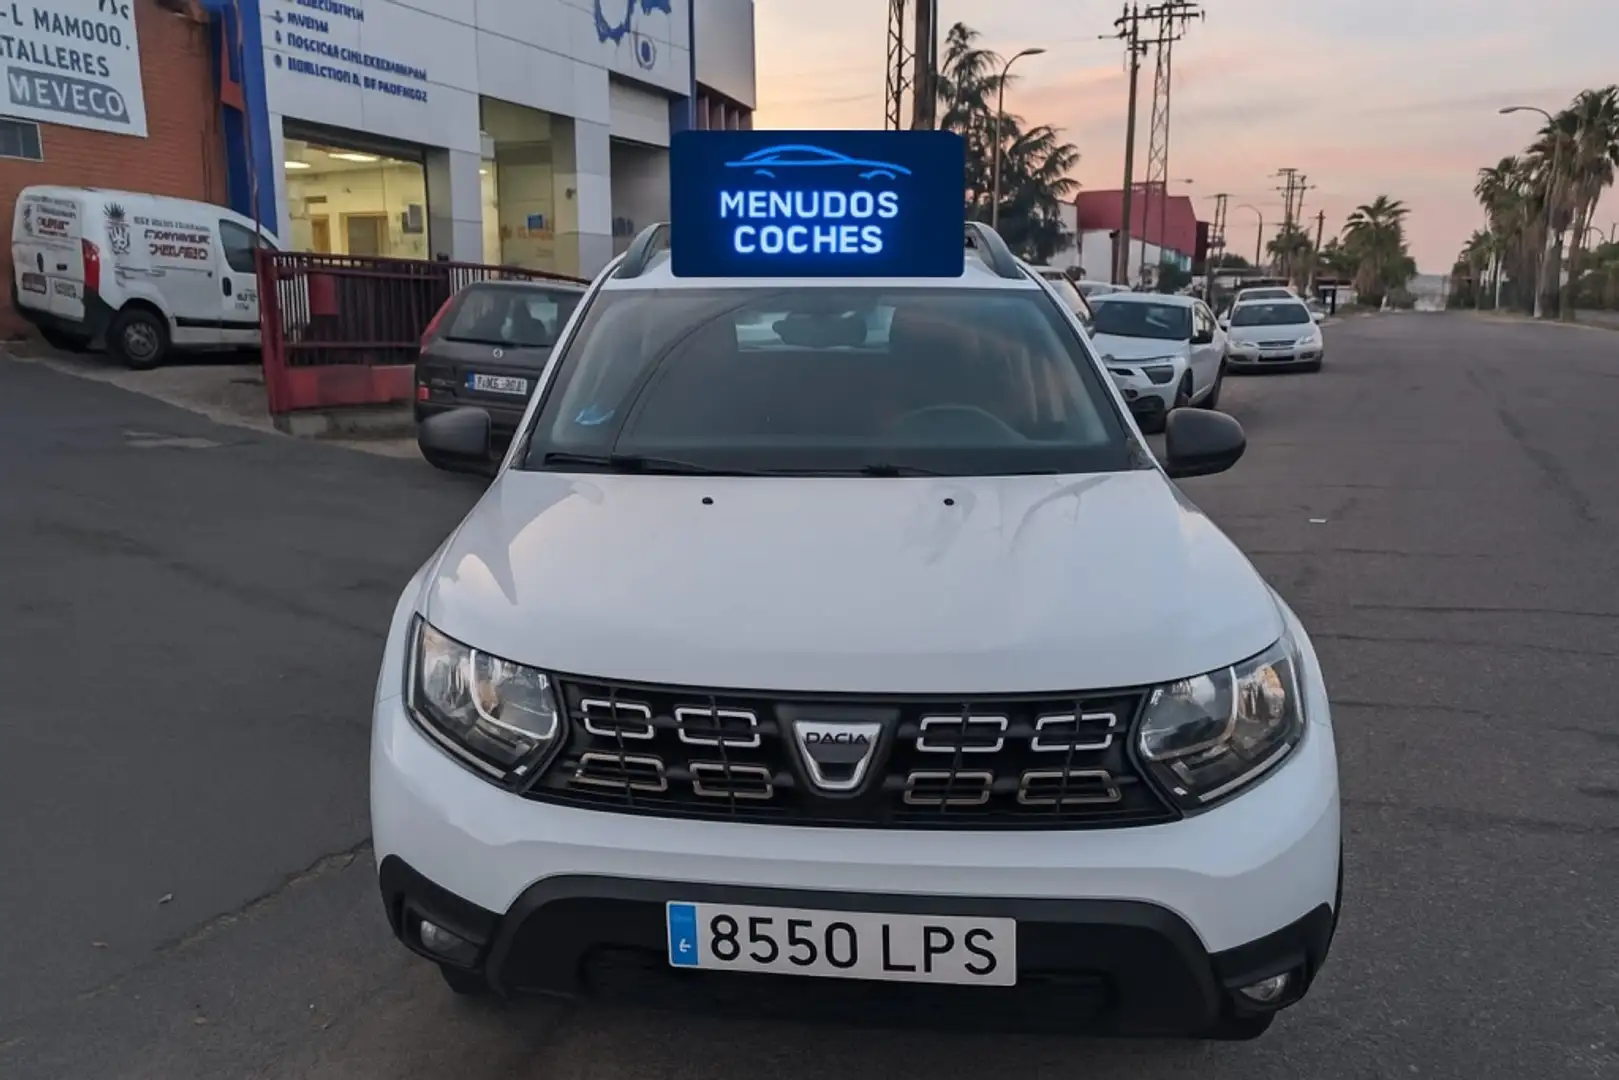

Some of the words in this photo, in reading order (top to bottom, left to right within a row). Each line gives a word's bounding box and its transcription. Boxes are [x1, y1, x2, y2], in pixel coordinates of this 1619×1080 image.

[9, 73, 125, 117] MEVECO
[720, 190, 899, 219] MENUDOS
[734, 225, 883, 254] COCHES
[805, 732, 870, 745] DACIA
[709, 914, 859, 969] 8550
[881, 923, 998, 976] LPS
